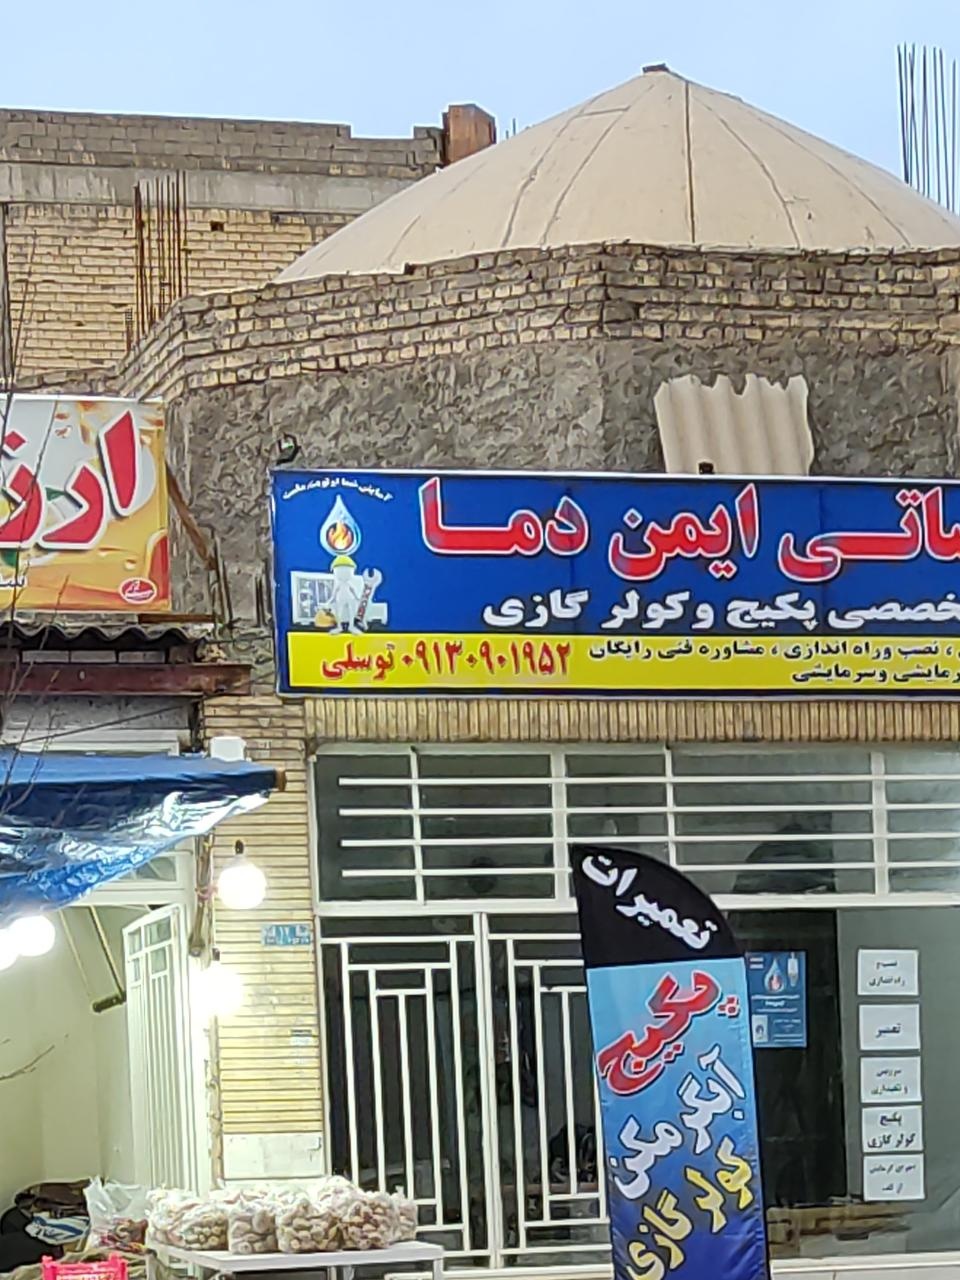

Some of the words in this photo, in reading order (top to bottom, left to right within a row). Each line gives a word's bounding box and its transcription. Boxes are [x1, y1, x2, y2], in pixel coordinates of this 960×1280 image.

[417, 476, 589, 556] دما
[608, 483, 760, 580] ایمن
[483, 590, 589, 628] گازی
[601, 589, 690, 629] کولر
[726, 590, 818, 631] پکیج
[321, 643, 396, 680] توسلی
[589, 640, 652, 660] رایگان
[658, 639, 693, 660] فنی
[699, 641, 765, 660] مشاوره
[784, 641, 847, 660] اندازی
[901, 641, 939, 660] نصب
[581, 855, 719, 949] تعمیرات
[596, 970, 739, 1096] پکیج
[684, 1135, 754, 1234] کولر
